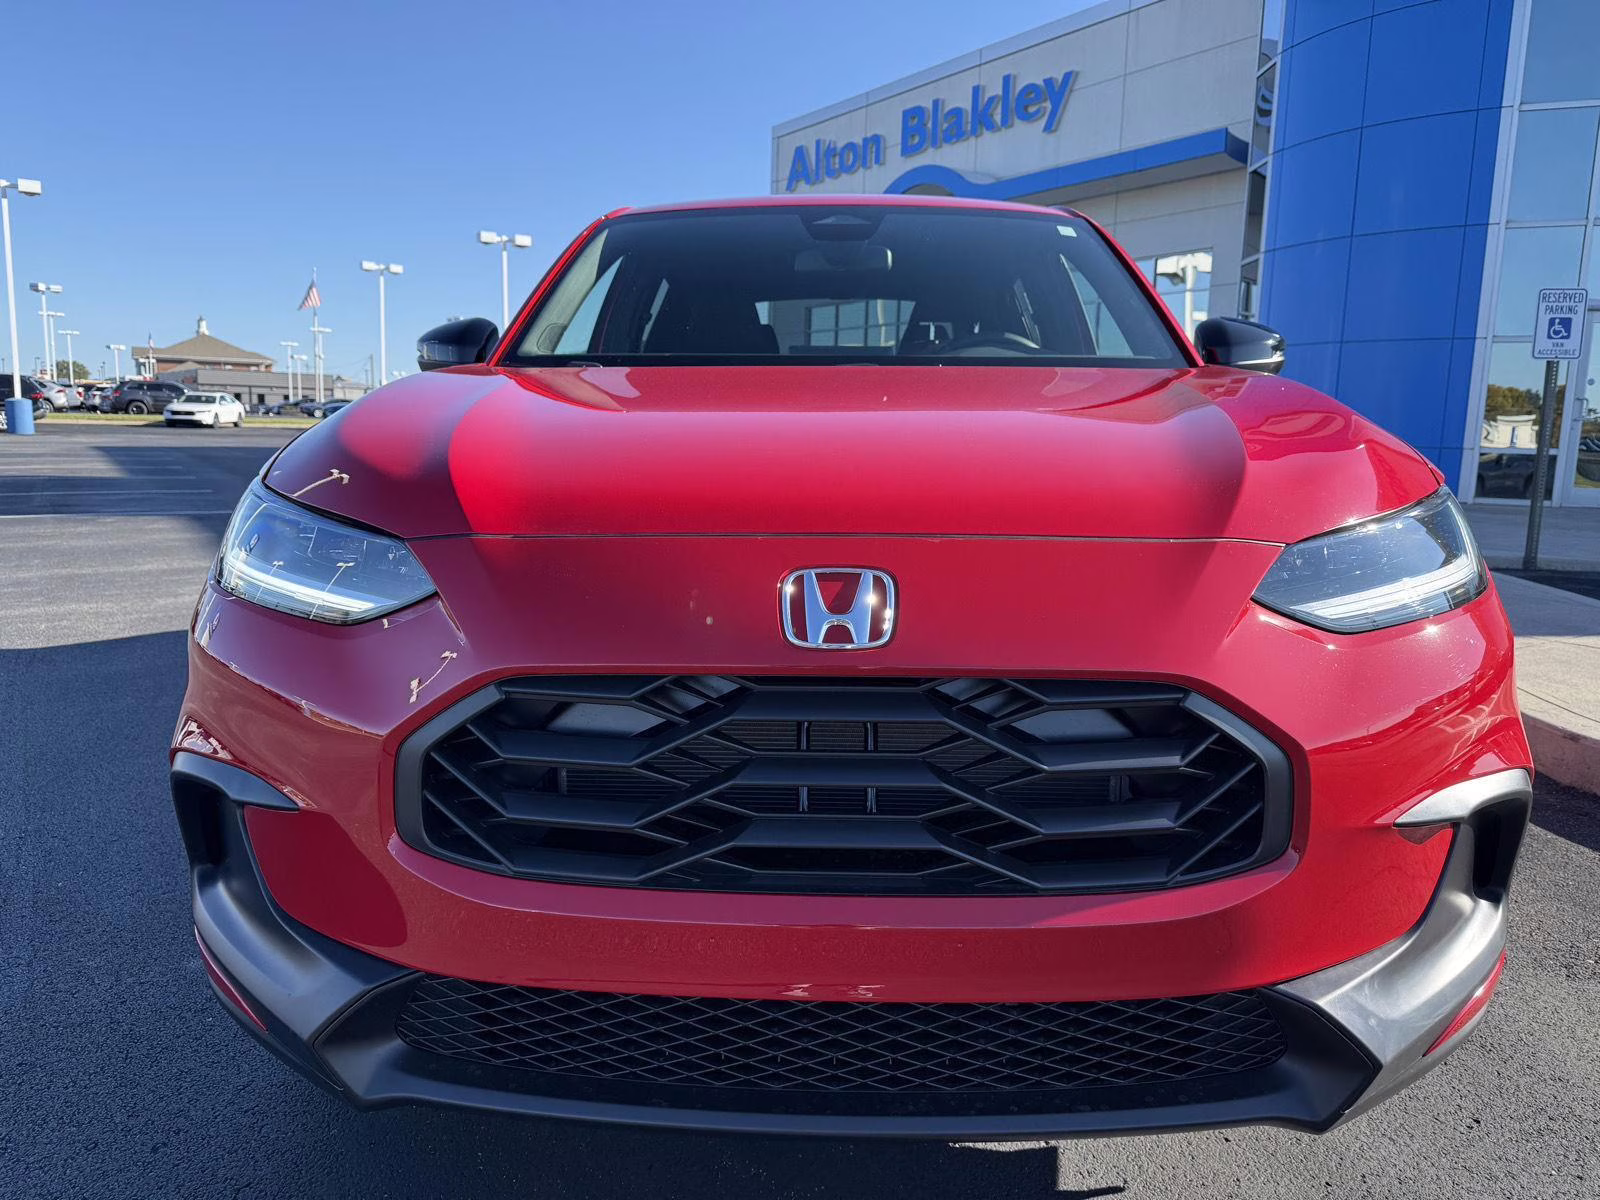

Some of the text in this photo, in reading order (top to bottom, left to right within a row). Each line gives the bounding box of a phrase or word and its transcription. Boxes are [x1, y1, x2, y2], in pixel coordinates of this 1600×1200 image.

[786, 69, 1079, 192] Alton Blakley
[1541, 292, 1584, 304] RESERVED
[1544, 304, 1579, 315] PARKING
[1537, 348, 1577, 356] ACCESSIBLE
